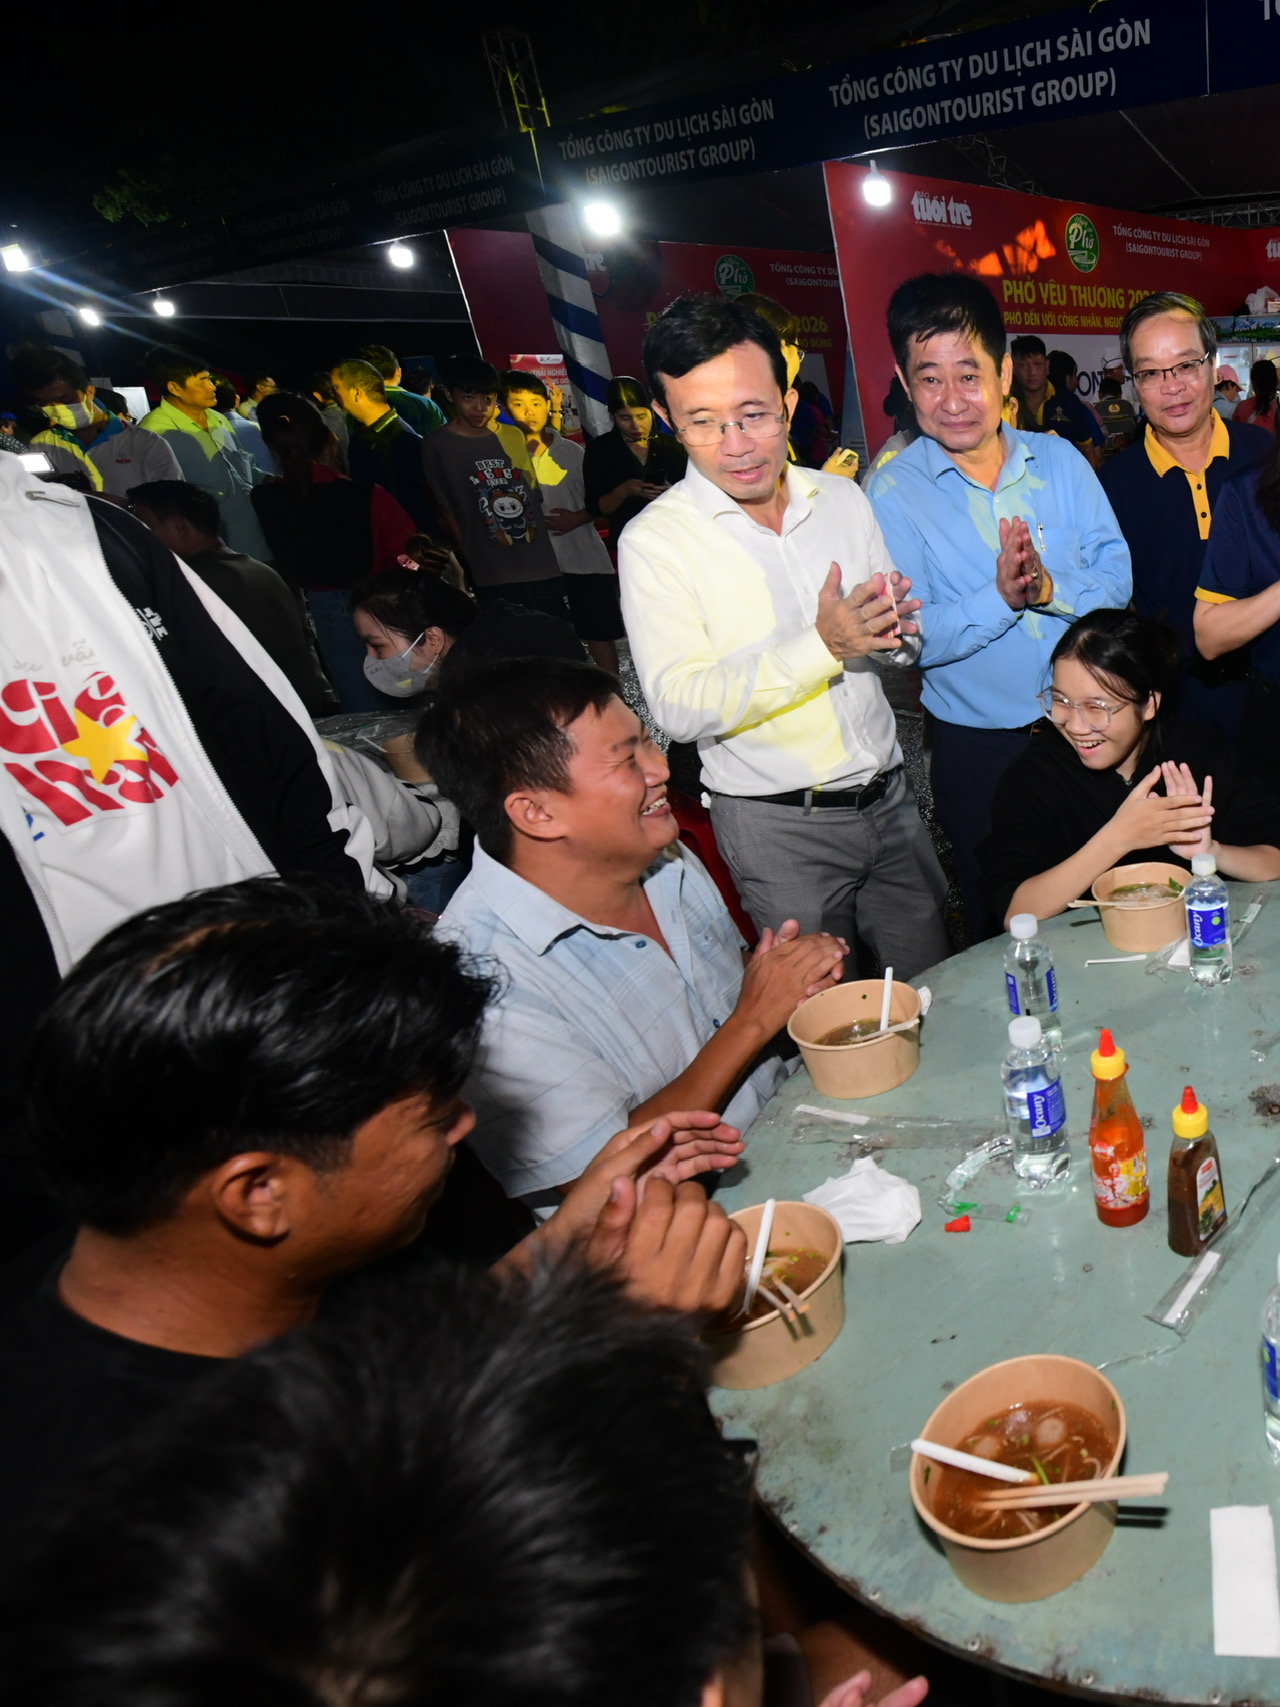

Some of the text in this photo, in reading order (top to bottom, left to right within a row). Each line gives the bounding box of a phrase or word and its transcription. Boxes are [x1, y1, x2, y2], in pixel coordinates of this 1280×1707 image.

[829, 18, 1151, 107] TỔNG CÔNG TY DU LỊCH SÀI GÒN
[864, 67, 1117, 140] (SAIGONTOURIST GROUP)
[559, 97, 775, 160] TỔNG CÔNG TY DU LỊCH SÀI GÒN
[586, 136, 756, 186] (SAIGONTOURIST GROUP)
[911, 191, 972, 226] tuổi trẻ
[1068, 223, 1095, 249] Phở
[1112, 223, 1210, 248] TỔNG CÔNG TY DU LỊCH SÀI GÒN
[1125, 242, 1203, 262] (SAIGONTOURIST GROUP)
[719, 263, 748, 285] Phở
[769, 261, 793, 274] TỔNG
[793, 263, 816, 275] CÔNG
[817, 266, 827, 275] TY
[1002, 276, 1038, 304] PHỞ
[1039, 279, 1067, 306] YÊU
[1069, 284, 1125, 309] THƯƠNG
[1003, 308, 1023, 325] PHỞ
[1041, 312, 1057, 326] VỚI
[1058, 311, 1080, 327] CÔNG
[475, 459, 504, 470] BEST
[1192, 911, 1203, 946] Ocany
[1033, 1094, 1047, 1128] Ocany
